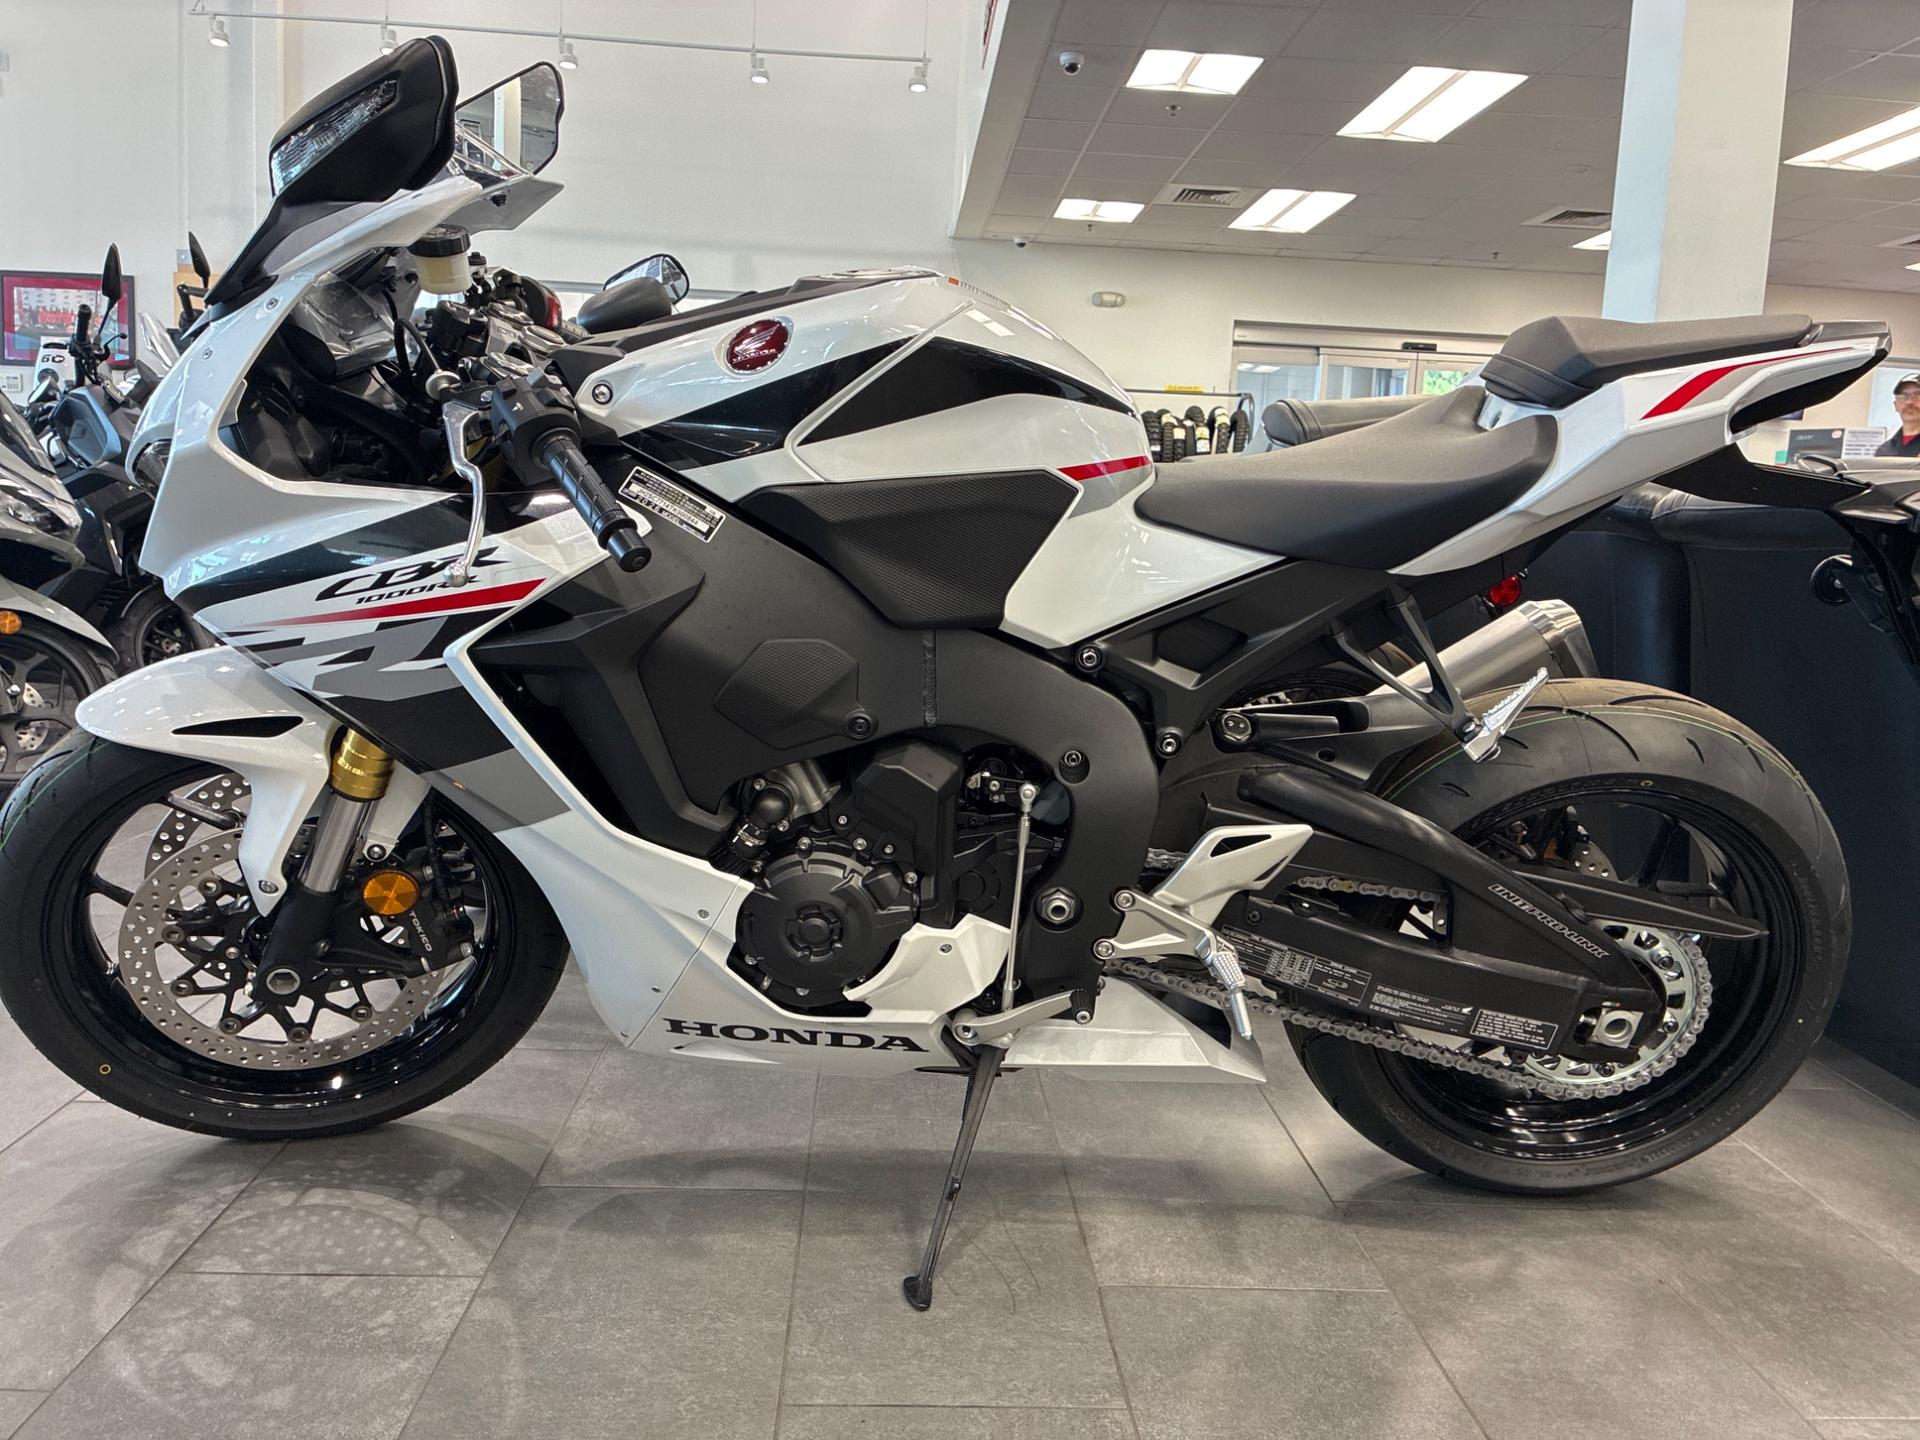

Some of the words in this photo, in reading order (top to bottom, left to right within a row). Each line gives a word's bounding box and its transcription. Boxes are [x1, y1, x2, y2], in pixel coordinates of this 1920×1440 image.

[315, 546, 511, 601] CBR
[409, 910, 433, 952] TOKICO
[663, 1018, 929, 1052] HONDA
